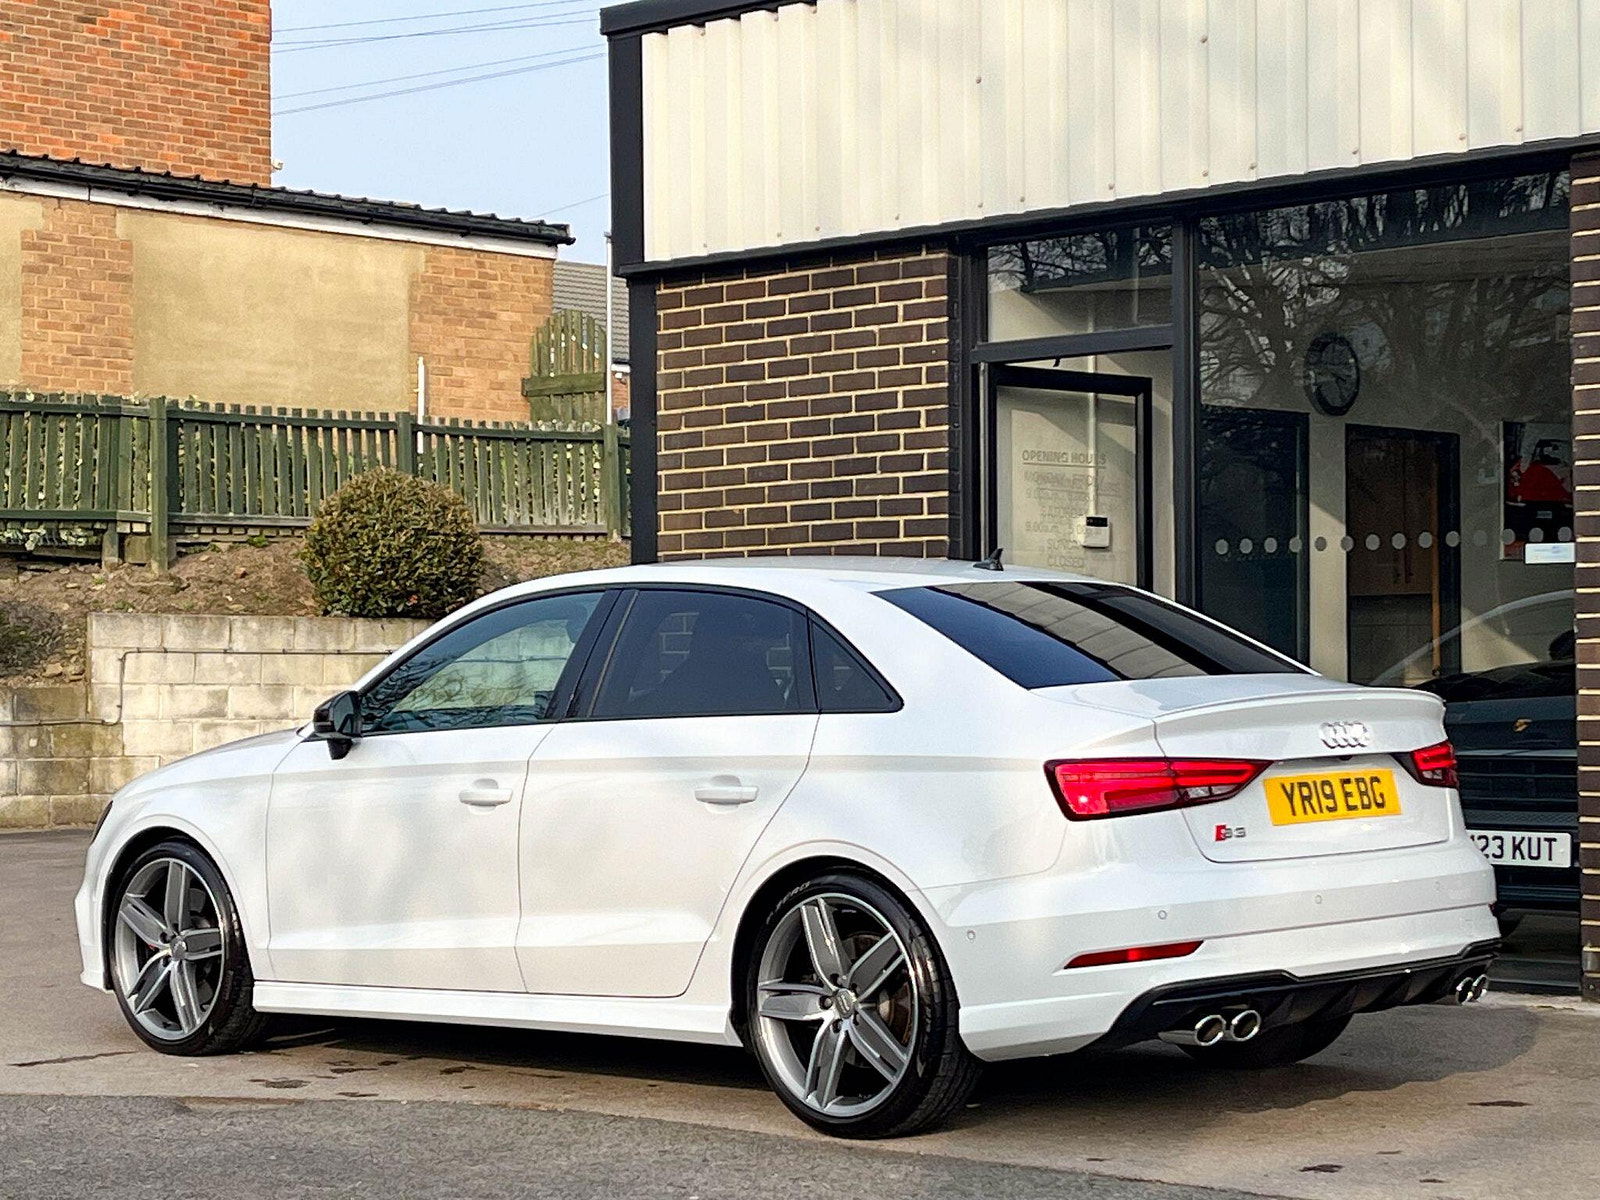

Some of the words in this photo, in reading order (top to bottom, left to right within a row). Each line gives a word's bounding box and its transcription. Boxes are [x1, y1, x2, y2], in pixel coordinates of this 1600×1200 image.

[1022, 449, 1069, 464] OPENING
[1071, 454, 1107, 466] HOUS
[1280, 779, 1339, 817] YR19
[1338, 776, 1387, 812] EBG
[1470, 834, 1505, 859] 23
[1511, 835, 1558, 862] KUT
